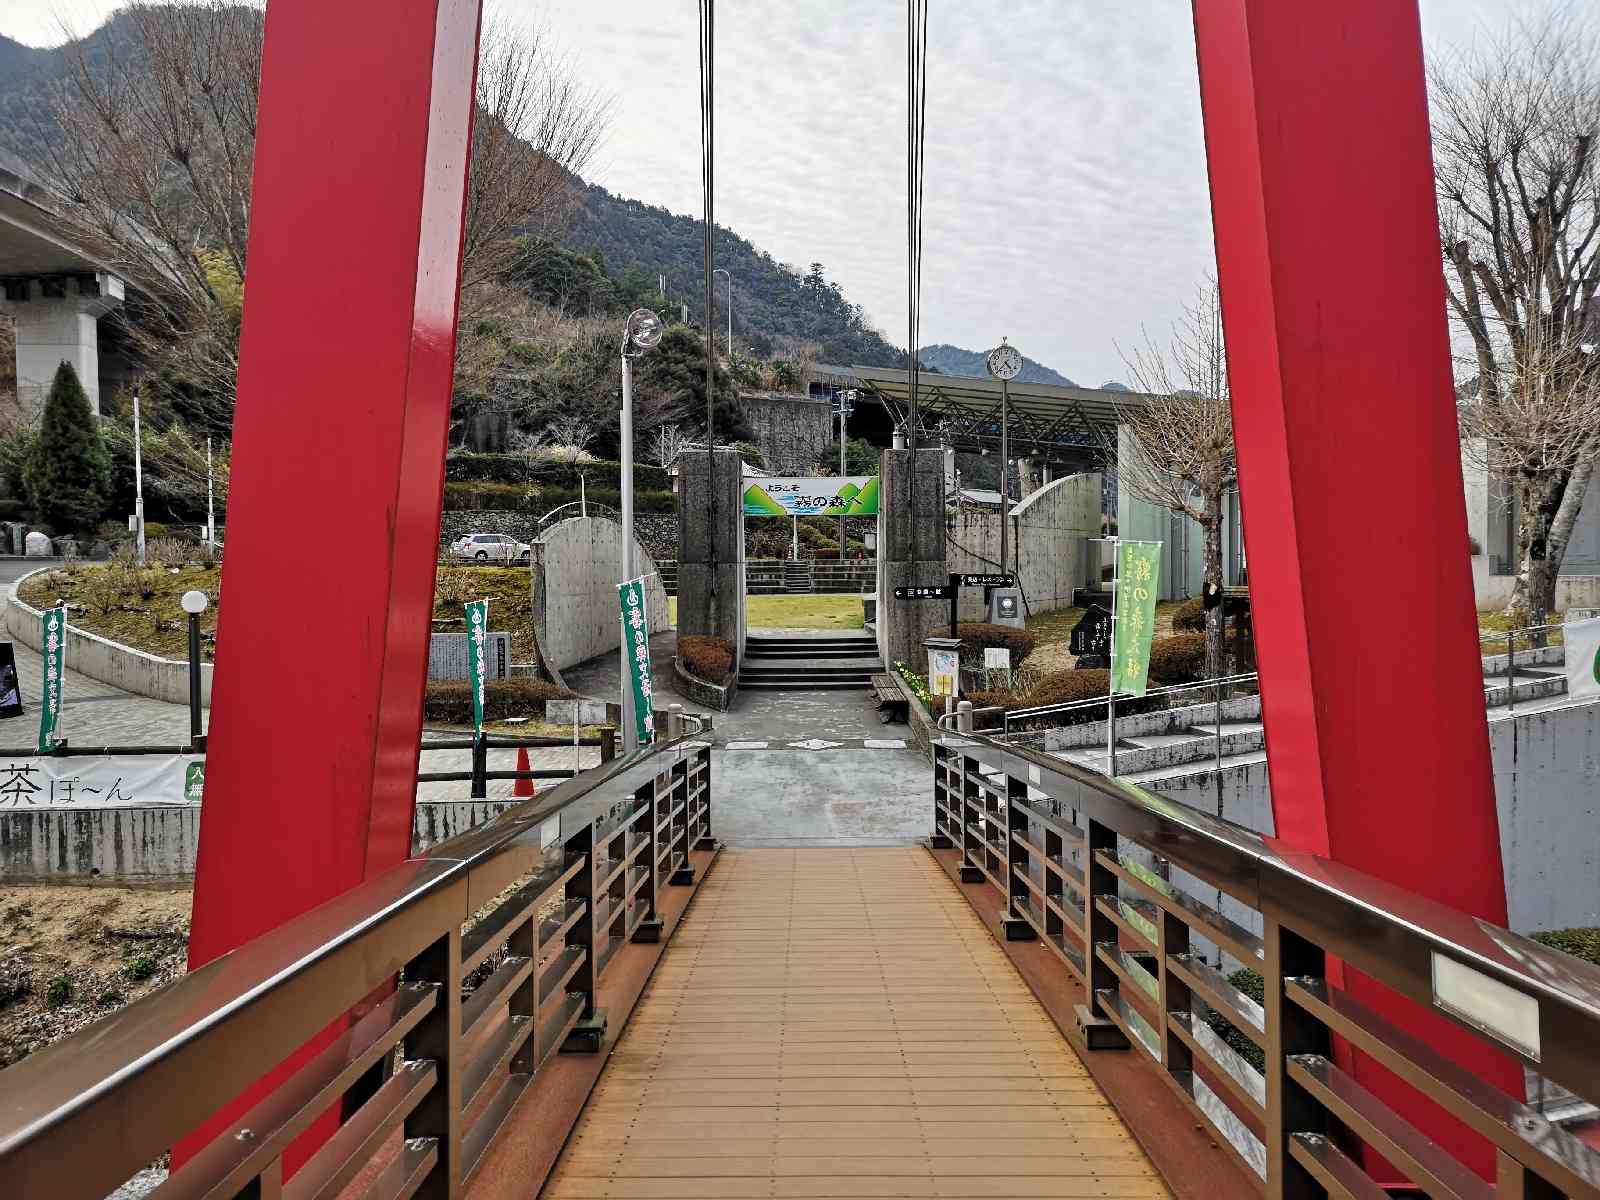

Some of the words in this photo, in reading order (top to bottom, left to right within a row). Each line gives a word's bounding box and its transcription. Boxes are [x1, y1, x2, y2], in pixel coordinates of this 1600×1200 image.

[765, 483, 801, 492] ようこそ
[793, 495, 863, 508] 霧の森へ
